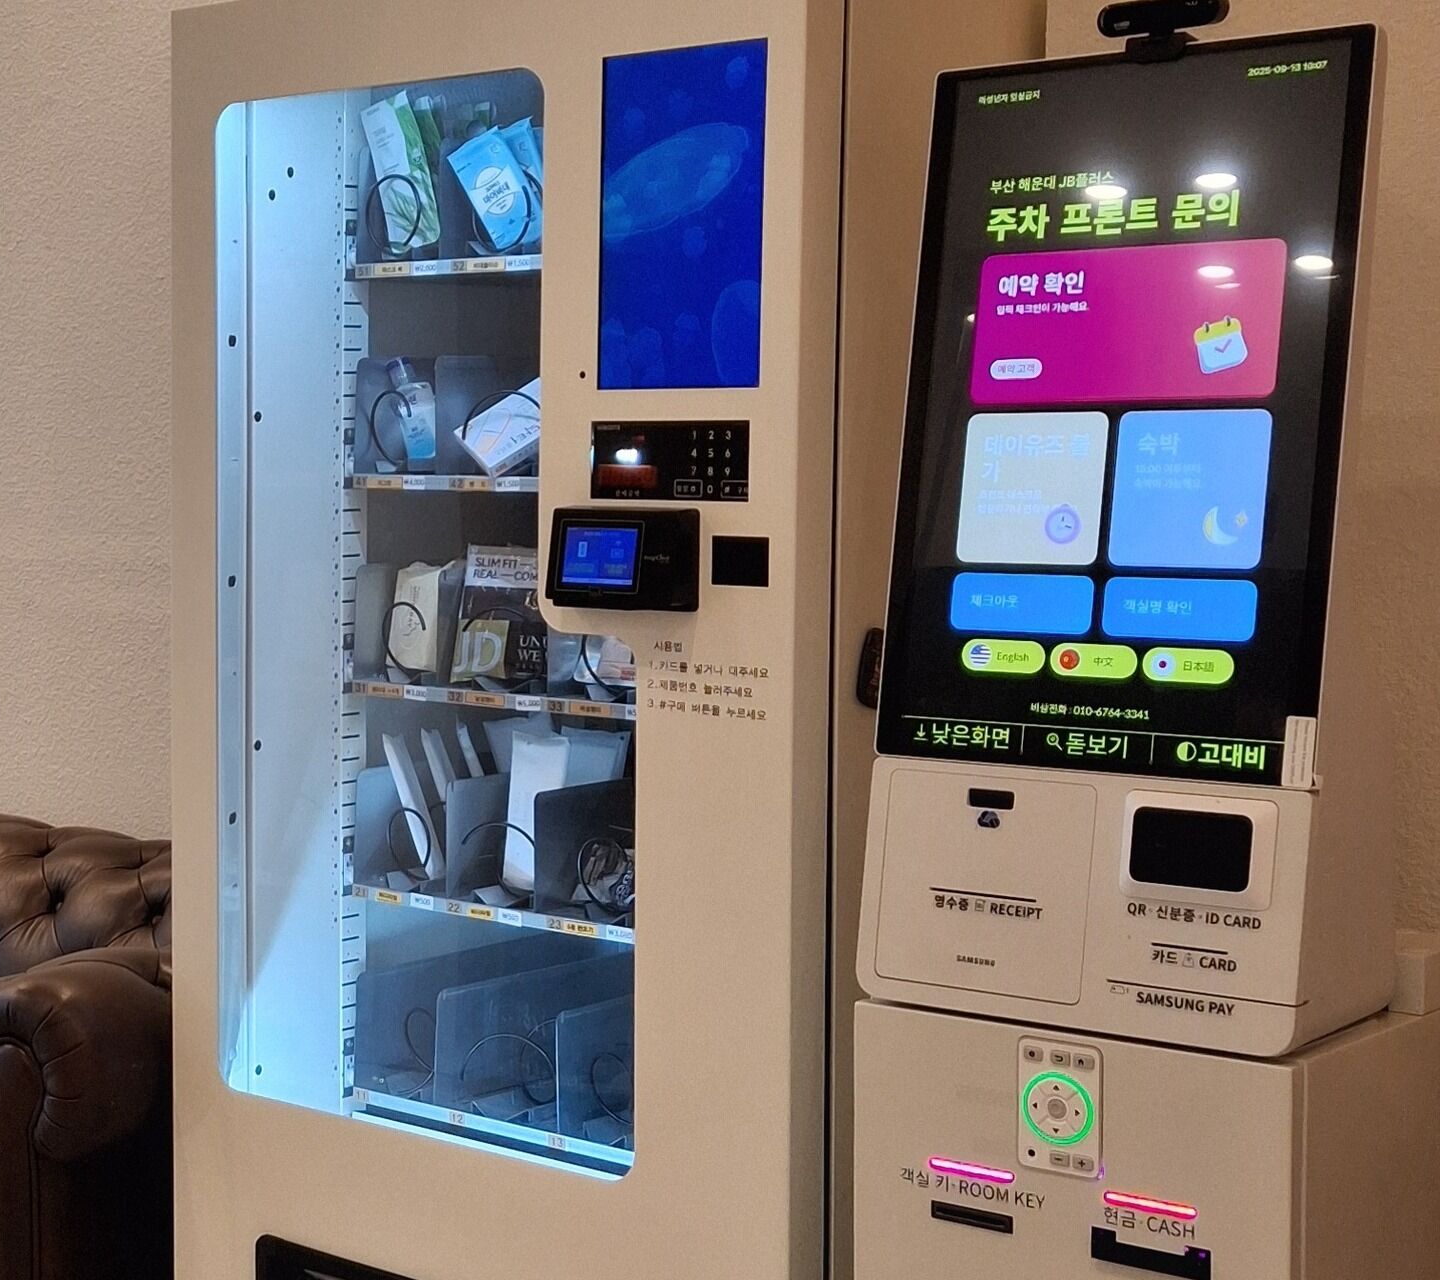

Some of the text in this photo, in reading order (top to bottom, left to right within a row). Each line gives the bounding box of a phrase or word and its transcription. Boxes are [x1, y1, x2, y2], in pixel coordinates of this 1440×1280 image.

[990, 171, 1114, 194] 부산 해운대 JB플러스
[986, 189, 1240, 242] 주차 프론트 문의
[998, 271, 1086, 297] 예약 확인
[997, 364, 1036, 374] 예약 고객
[708, 430, 715, 440] 2
[725, 430, 732, 440] 3
[984, 434, 1065, 457] 데이유즈
[1138, 433, 1181, 456] 숙박
[690, 448, 731, 458] 4 5 6
[691, 466, 731, 476] 7 8 9
[982, 460, 1000, 482] 가
[707, 484, 713, 494] 0
[475, 556, 518, 569] SLIM FIT
[473, 568, 499, 579] REAL
[970, 591, 1019, 609] 체크아웃
[1123, 598, 1193, 616] 객실명 확인
[454, 630, 502, 674] JD
[996, 649, 1030, 664] English
[1093, 655, 1114, 668] 中文
[1182, 659, 1215, 674] 日本語
[728, 665, 769, 679] 대주세요
[448, 691, 462, 703] 32
[703, 683, 753, 698] 눌러주세요
[549, 700, 563, 712] 33
[1072, 705, 1150, 720] 010-6764-3341
[726, 707, 767, 721] 누르세요
[931, 723, 1011, 751] 낮은화면
[1065, 732, 1129, 760] 돋보기
[1197, 741, 1266, 771] 고대비
[448, 902, 460, 913] 22
[933, 894, 1043, 920] 영수증 RECEIPT
[549, 919, 561, 929] 23
[1127, 902, 1262, 931] QR 신분증 ID CARD
[956, 954, 996, 968] SAMSUNG
[1151, 948, 1237, 973] 카드 CARD
[1135, 990, 1236, 1017] SAMSUNG PAY
[900, 1166, 929, 1188] 객실
[958, 1180, 1009, 1205] ROOM
[1014, 1189, 1046, 1211] KEY
[1103, 1206, 1196, 1241] 현금 CASH
